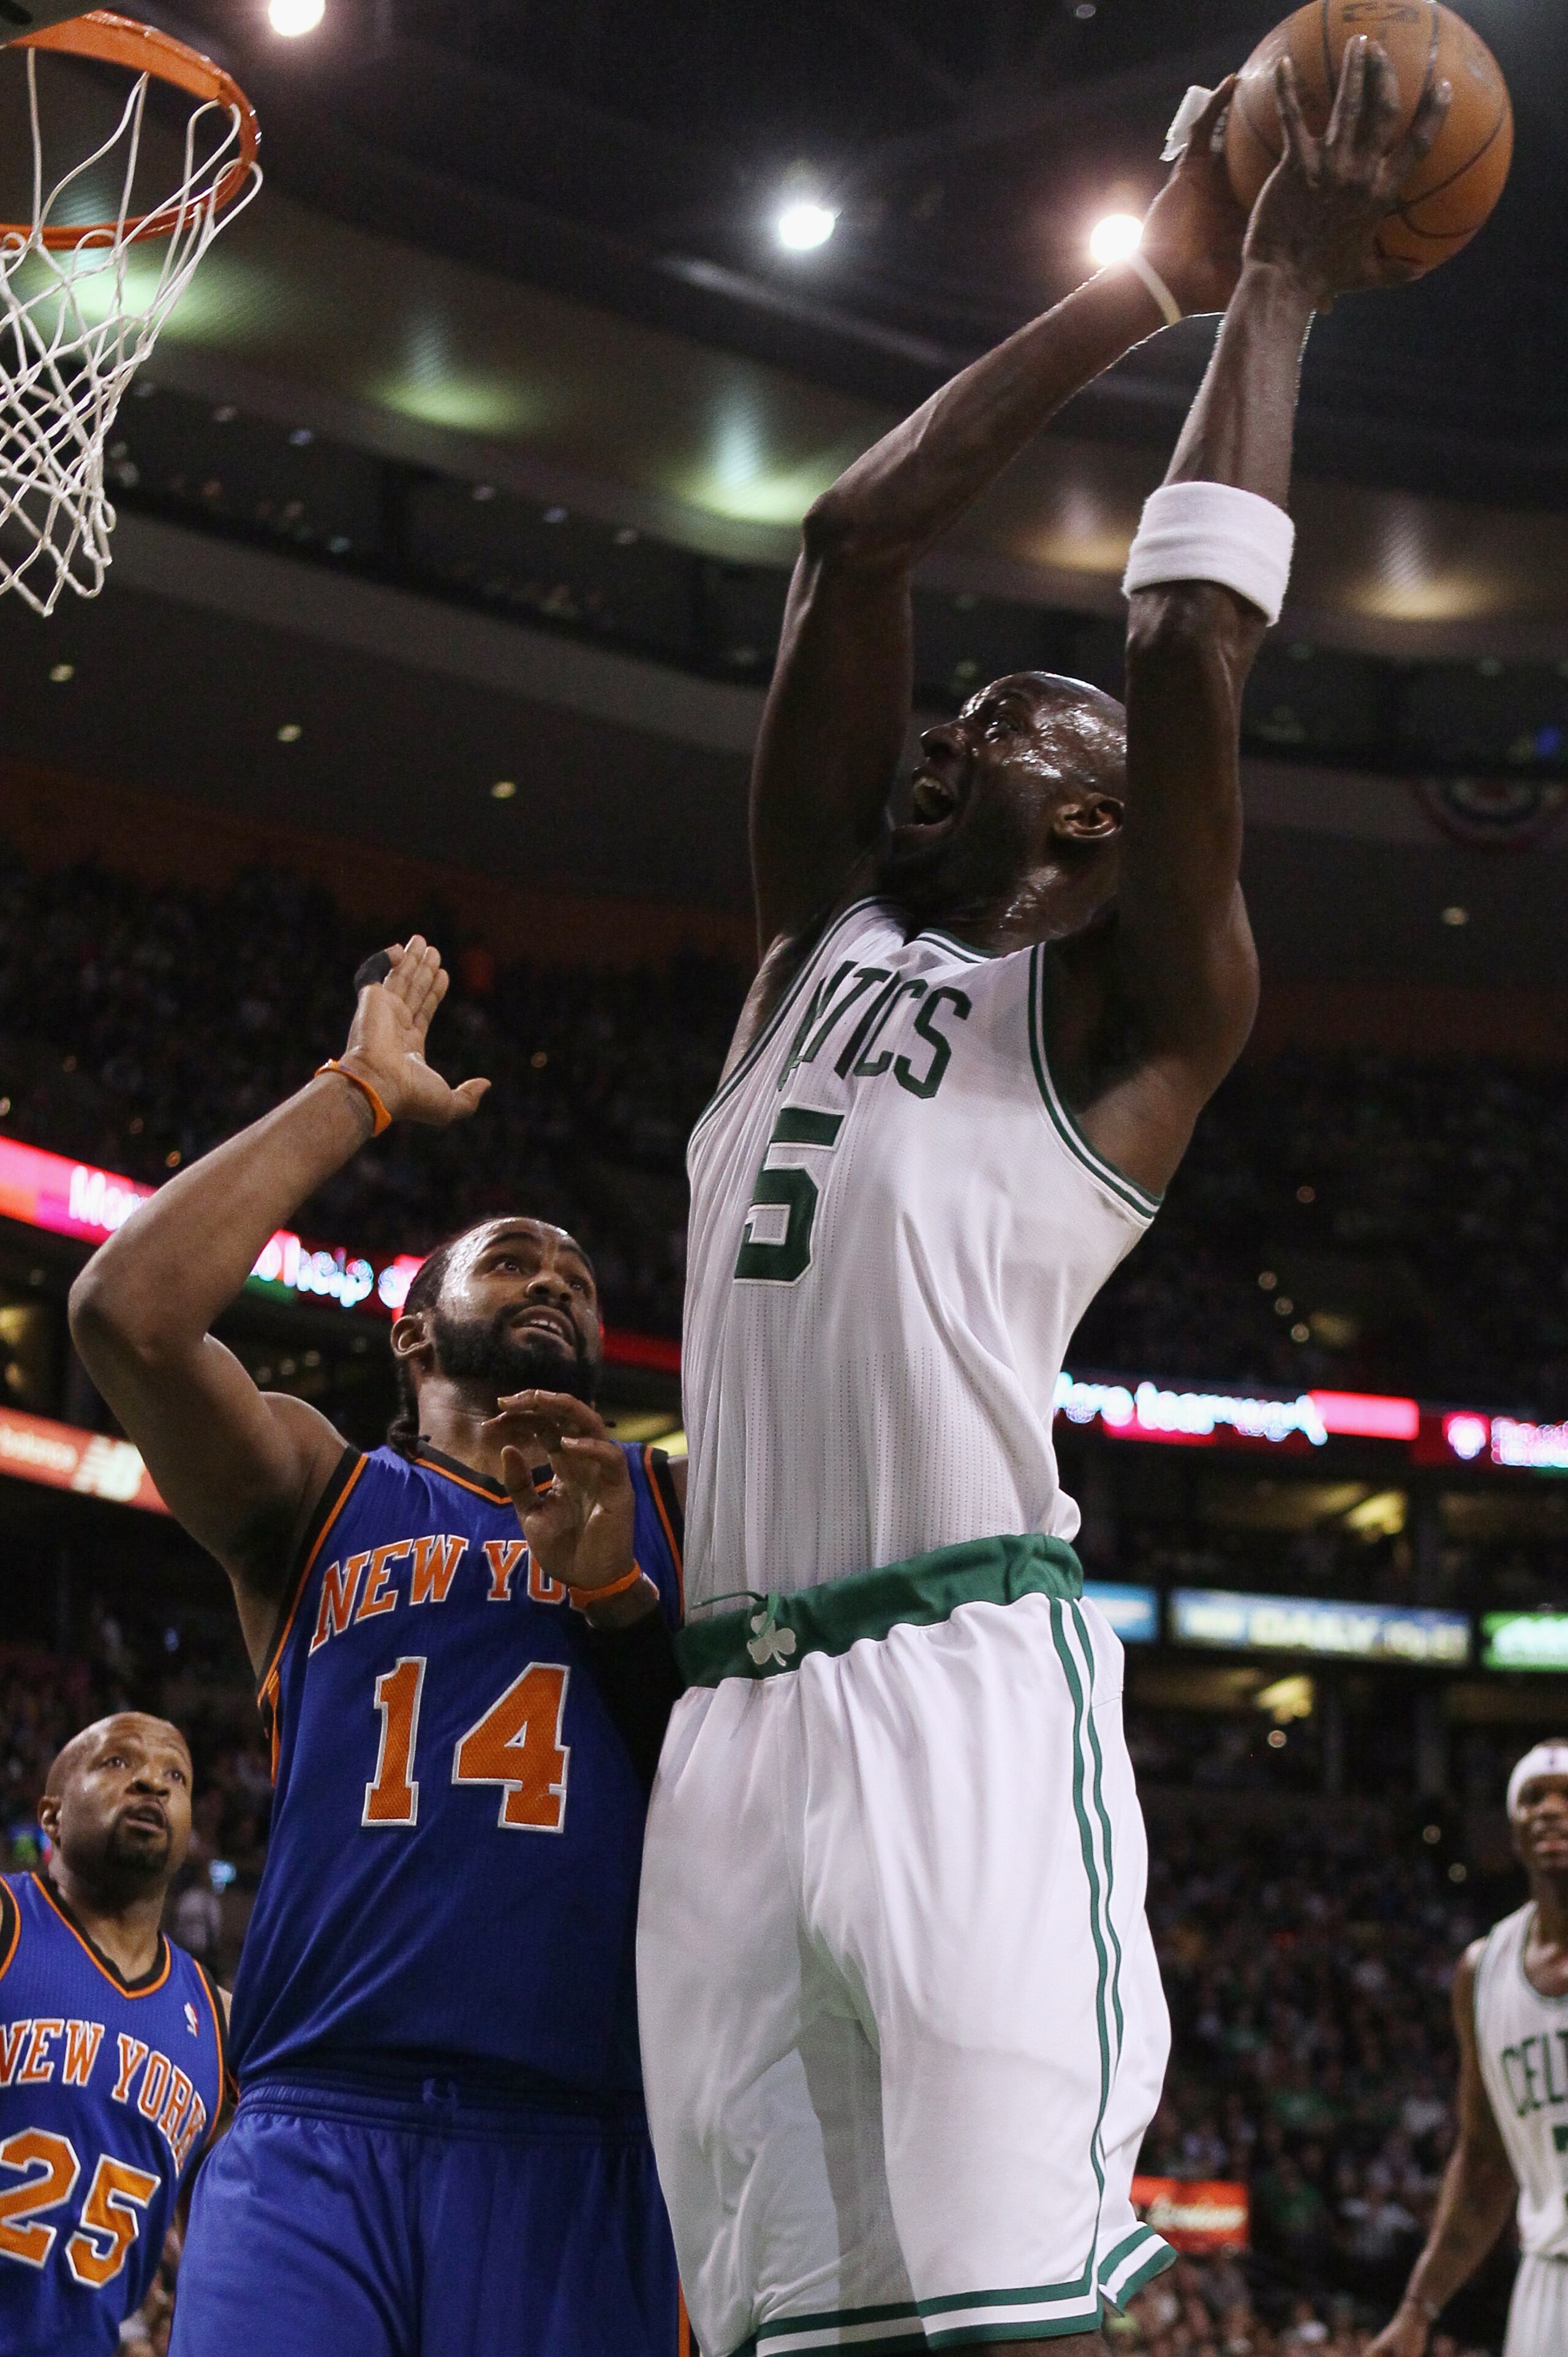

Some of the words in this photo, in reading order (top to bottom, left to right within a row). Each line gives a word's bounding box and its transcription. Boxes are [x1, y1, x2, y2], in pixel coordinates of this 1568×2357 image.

[734, 1102, 846, 1287] 5
[308, 1534, 469, 1657] NEW
[361, 1655, 570, 1834] 14
[0, 2018, 105, 2087] NEW
[111, 2032, 207, 2179] YORK
[0, 2127, 161, 2289] 25
